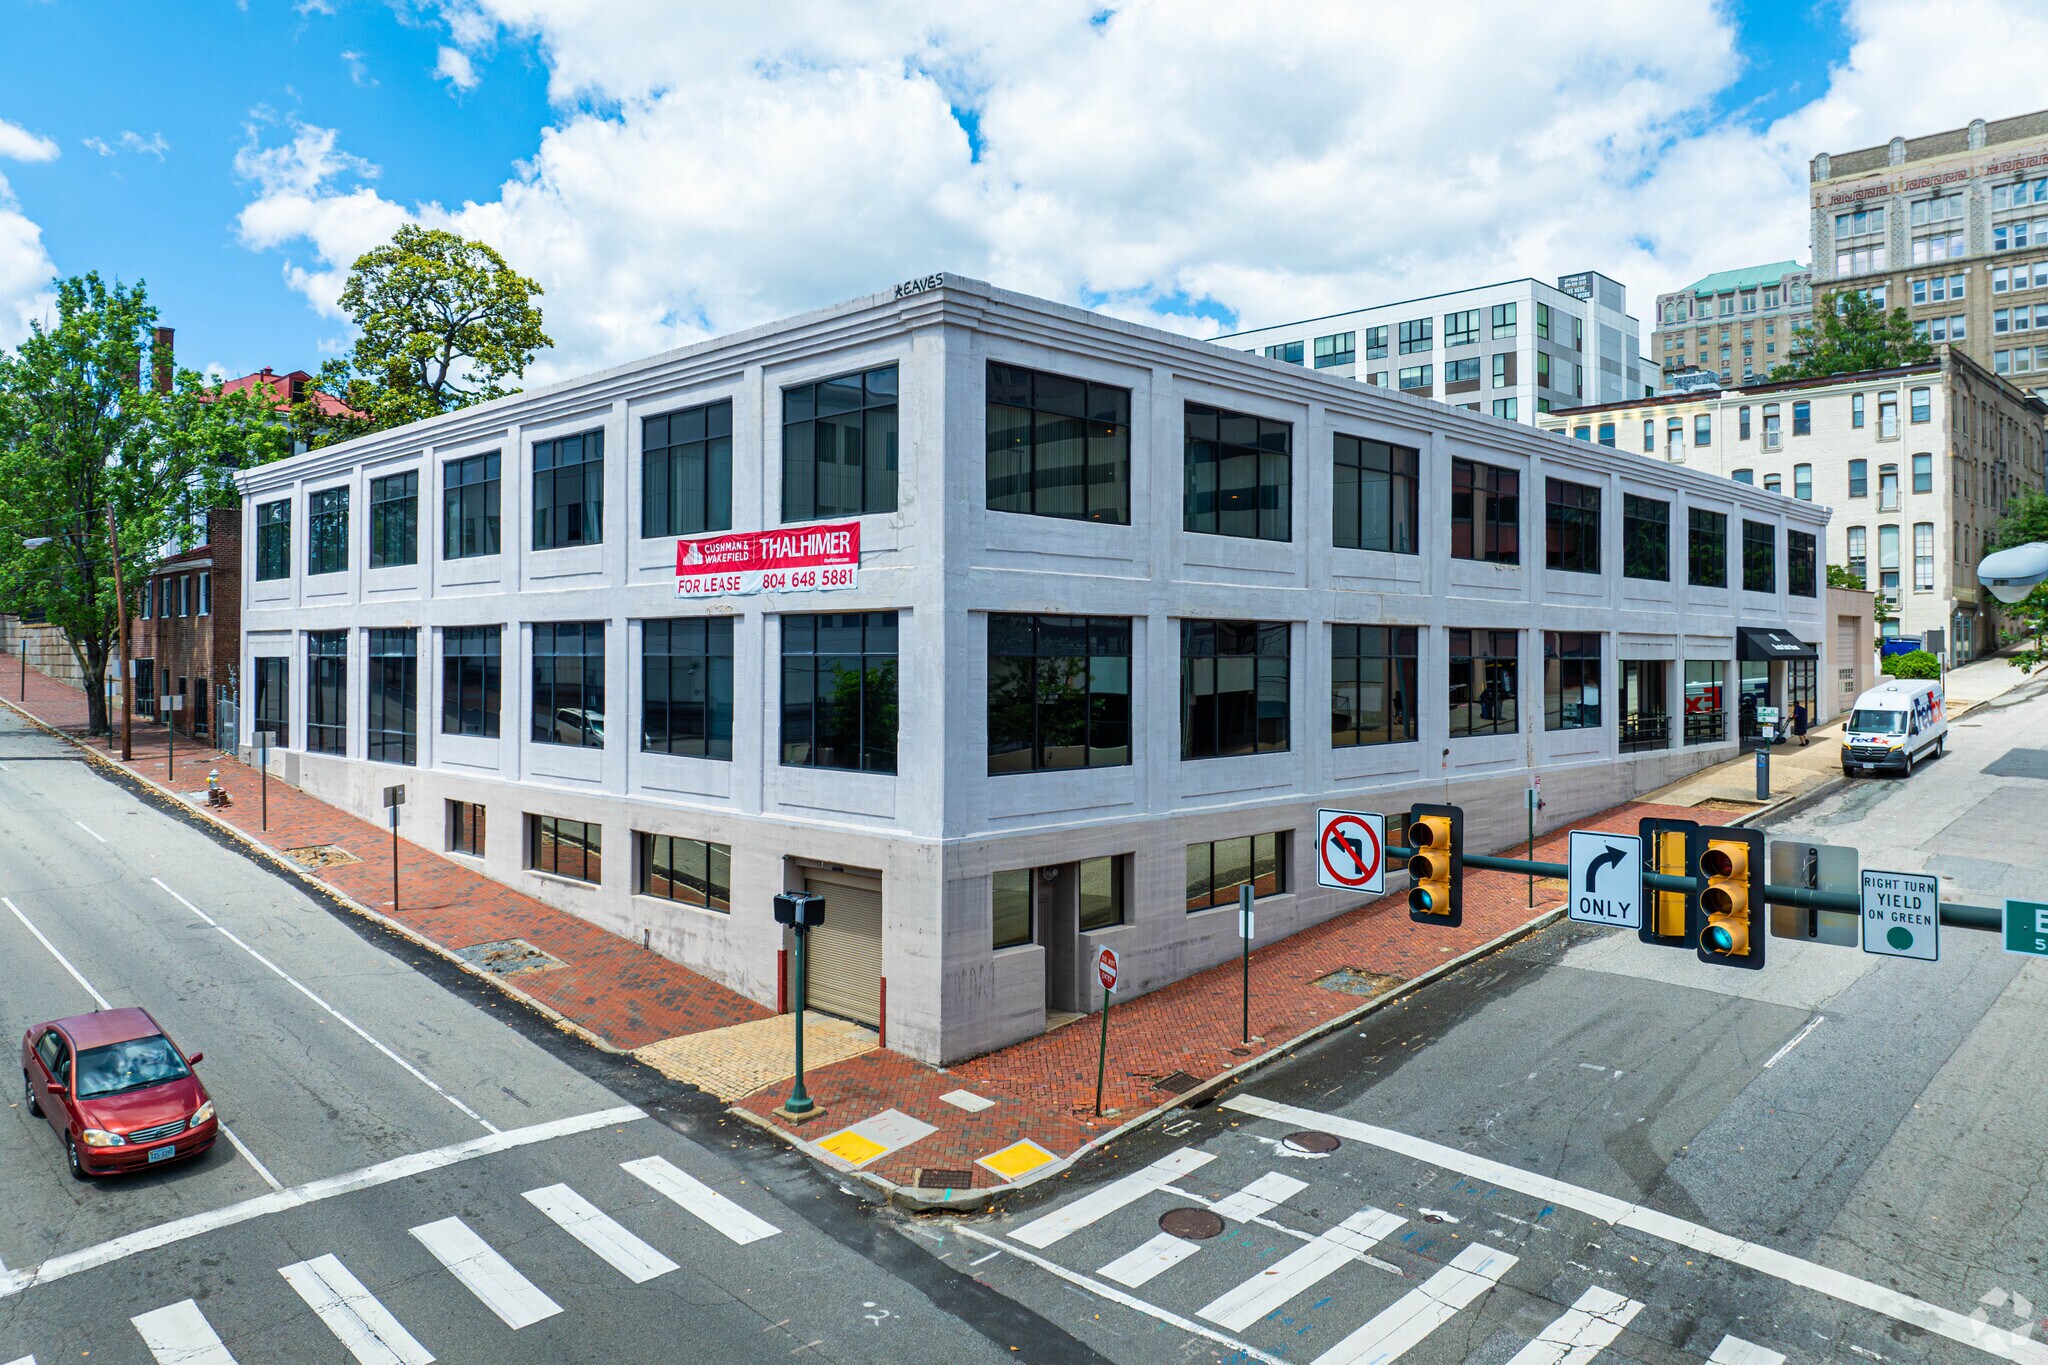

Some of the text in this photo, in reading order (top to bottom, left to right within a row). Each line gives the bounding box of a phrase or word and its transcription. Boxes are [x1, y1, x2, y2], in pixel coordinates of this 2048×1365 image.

[704, 540, 749, 553] CUSHMAN &
[759, 531, 850, 559] THALHIMER
[705, 552, 749, 564] WAKEFIELD
[678, 576, 741, 593] FOR LEASE
[762, 568, 853, 589] 804 648 5881
[1914, 691, 1943, 731] FedEx
[1850, 737, 1889, 745] FedEx
[1864, 877, 1934, 893] RIGHT TURN
[1580, 897, 1631, 919] ONLY
[1877, 893, 1921, 909] YIELD
[1868, 909, 1931, 925] ON GREEN
